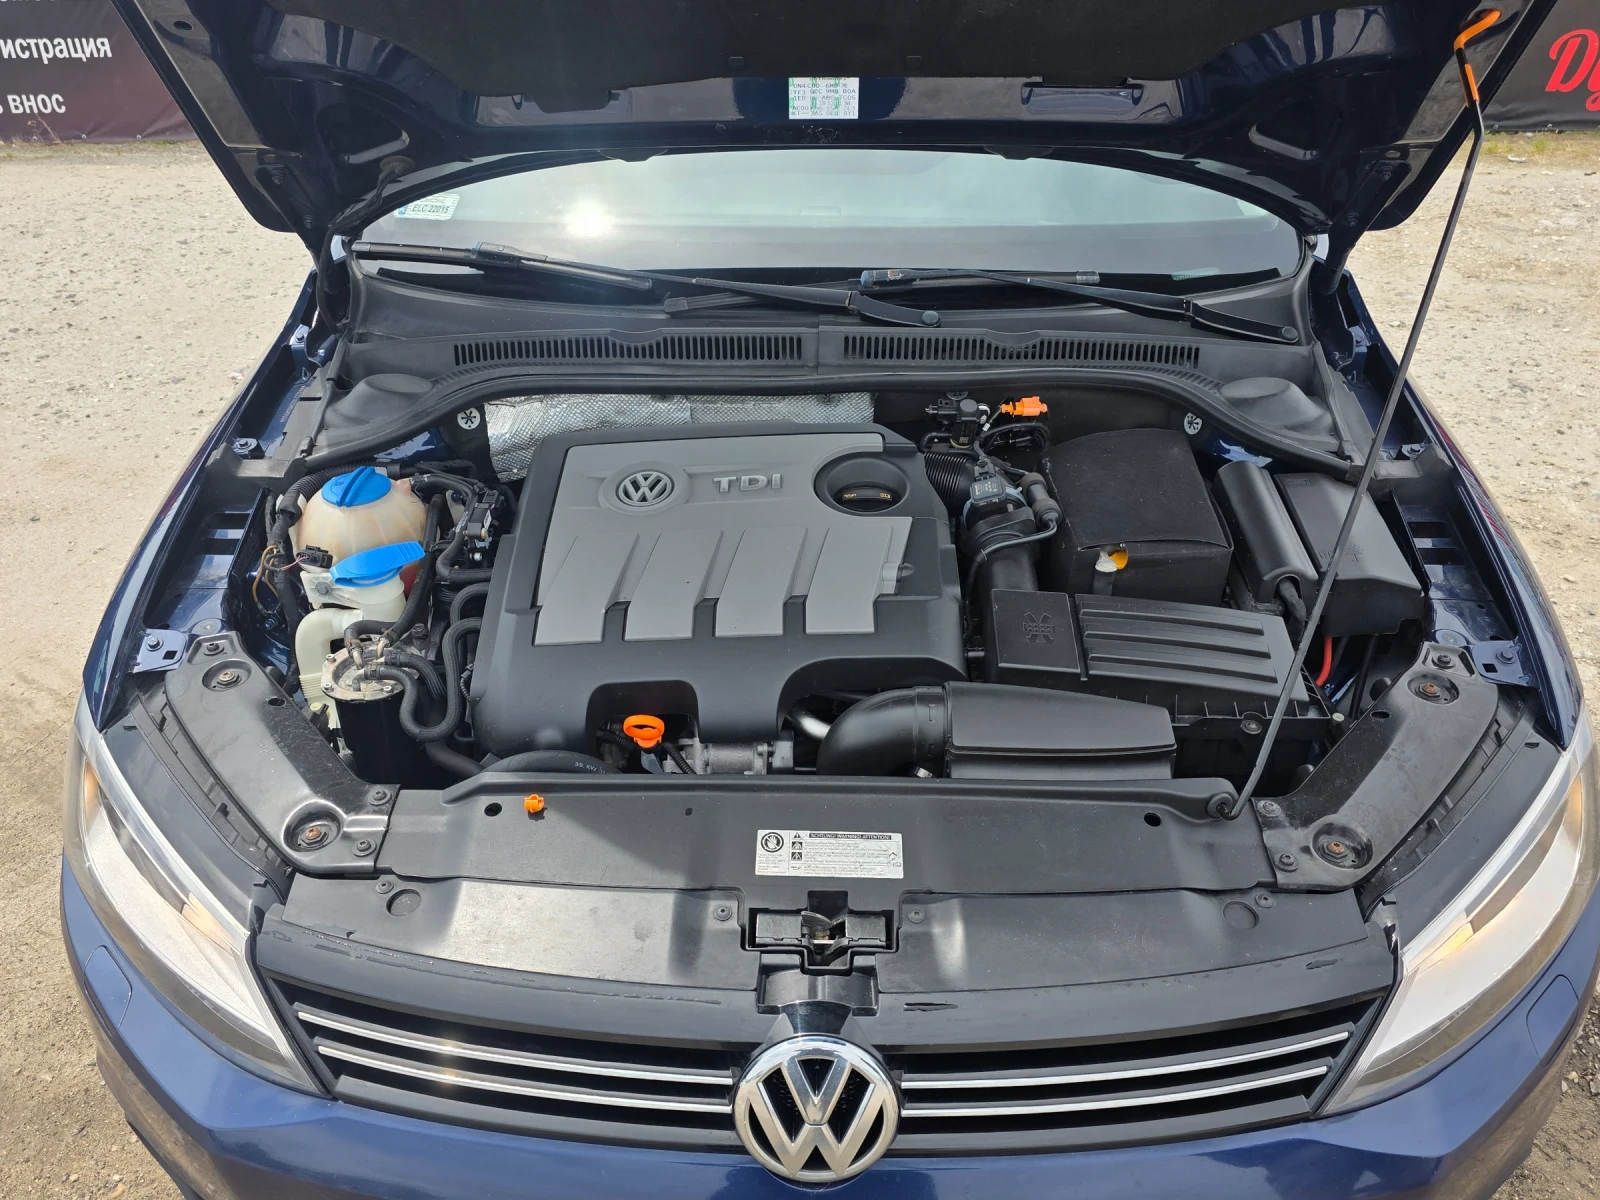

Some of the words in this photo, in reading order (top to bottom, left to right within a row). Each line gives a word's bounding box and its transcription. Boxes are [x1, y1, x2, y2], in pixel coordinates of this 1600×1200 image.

[0, 37, 113, 64] истрация
[7, 93, 67, 114] внос
[412, 203, 428, 212] ELC
[427, 205, 450, 213] 22015
[712, 473, 783, 493] TDI
